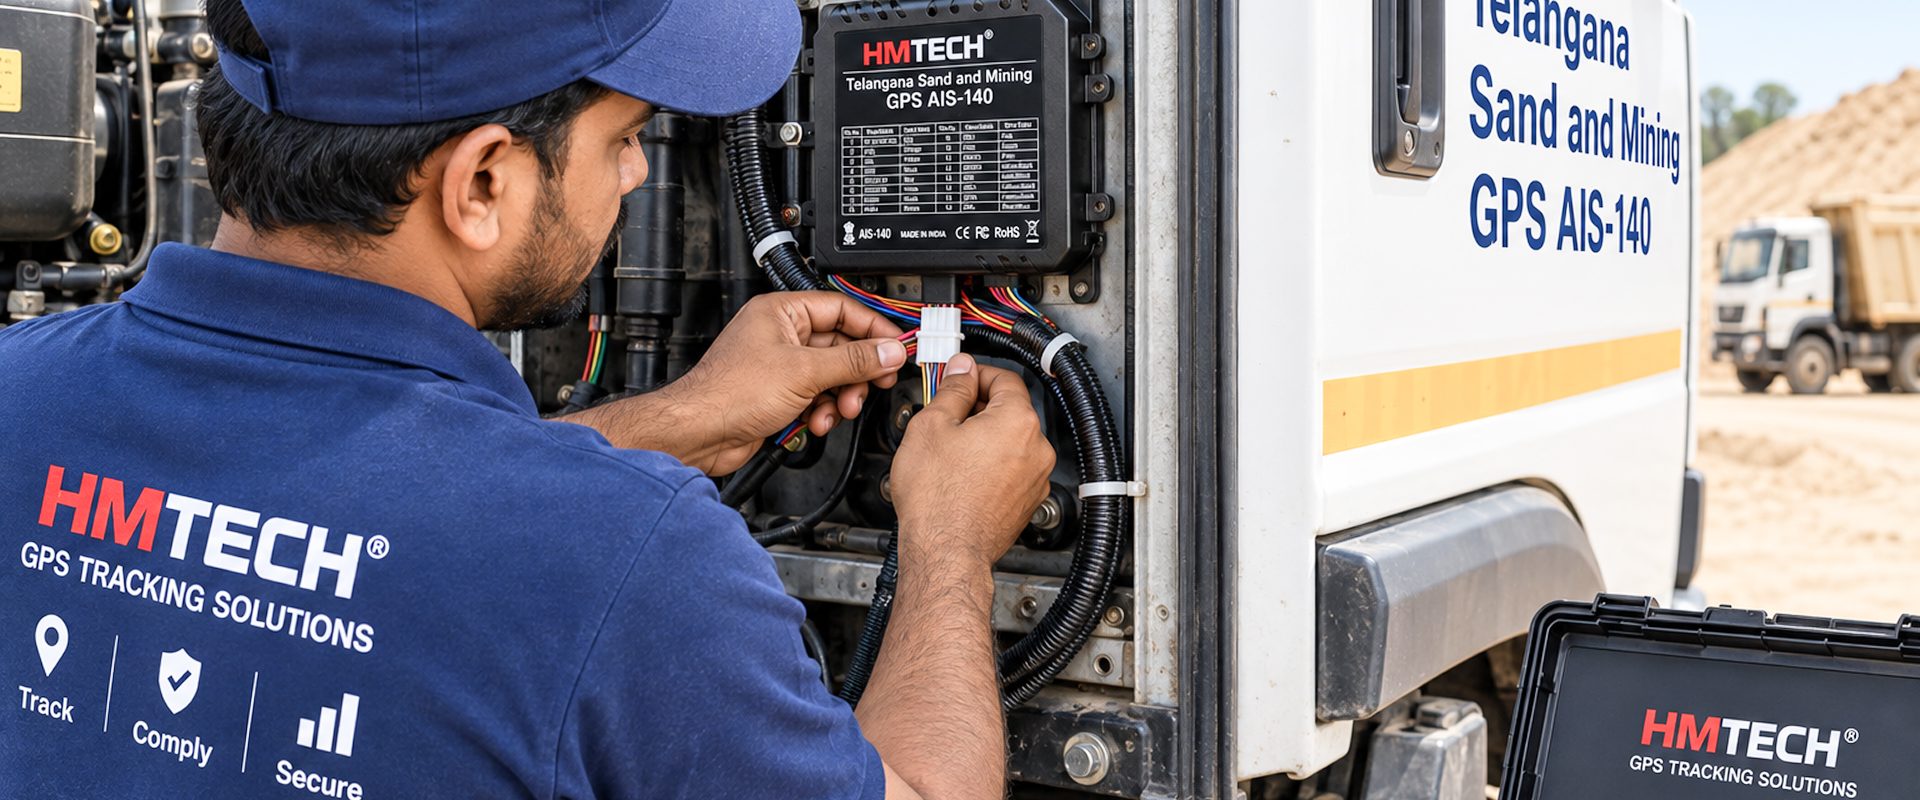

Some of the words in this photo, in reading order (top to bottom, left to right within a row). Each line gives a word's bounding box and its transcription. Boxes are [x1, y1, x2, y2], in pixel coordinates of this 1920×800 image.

[846, 77, 914, 92] Telangana
[918, 72, 952, 88] Sand
[956, 70, 982, 84] and
[985, 67, 1032, 83] Mining
[886, 92, 922, 109] GPS
[927, 87, 993, 108] AIS-140
[1469, 64, 1557, 149] Sand
[1568, 98, 1614, 159] and
[1621, 102, 1680, 185] Mining
[858, 228, 892, 239] AIS-140
[994, 226, 1020, 239] RoHS
[1469, 173, 1546, 251] GPS
[1557, 186, 1651, 256] AIS-140
[20, 541, 71, 577] GPS
[79, 555, 205, 613] TRACKING
[212, 590, 375, 654] SOLUTIONS
[18, 685, 75, 723] Track
[132, 720, 214, 768] Comply
[275, 759, 364, 800] Secure
[1629, 755, 1664, 774] GPS
[1669, 759, 1754, 785] TRACKING
[1757, 771, 1858, 799] SOLUTIONS
